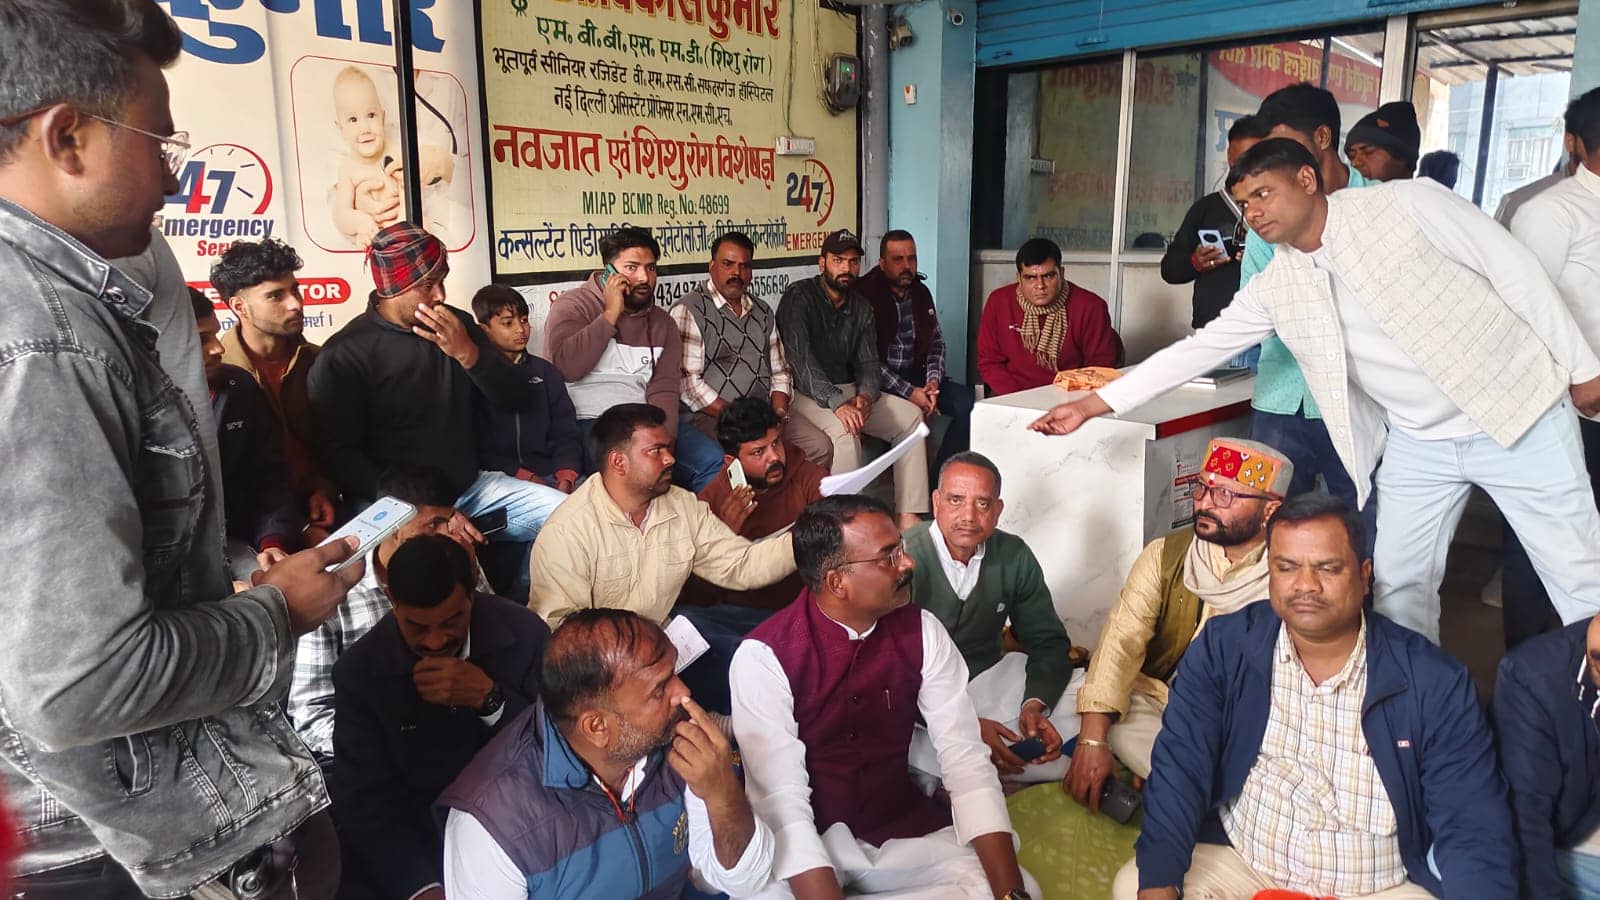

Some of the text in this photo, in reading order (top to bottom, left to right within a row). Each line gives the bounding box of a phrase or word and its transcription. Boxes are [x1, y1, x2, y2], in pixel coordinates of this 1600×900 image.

[541, 50, 587, 79] सीनियर
[554, 84, 573, 116] नई
[574, 85, 607, 117] दिल्ली
[493, 124, 603, 177] नवजात
[606, 130, 631, 180] एवं
[165, 160, 237, 214] 47
[582, 190, 616, 215] MIAP
[622, 192, 654, 216] BCMR
[657, 193, 678, 219] Reg.
[699, 194, 730, 215] 48699
[160, 215, 274, 241] mergency
